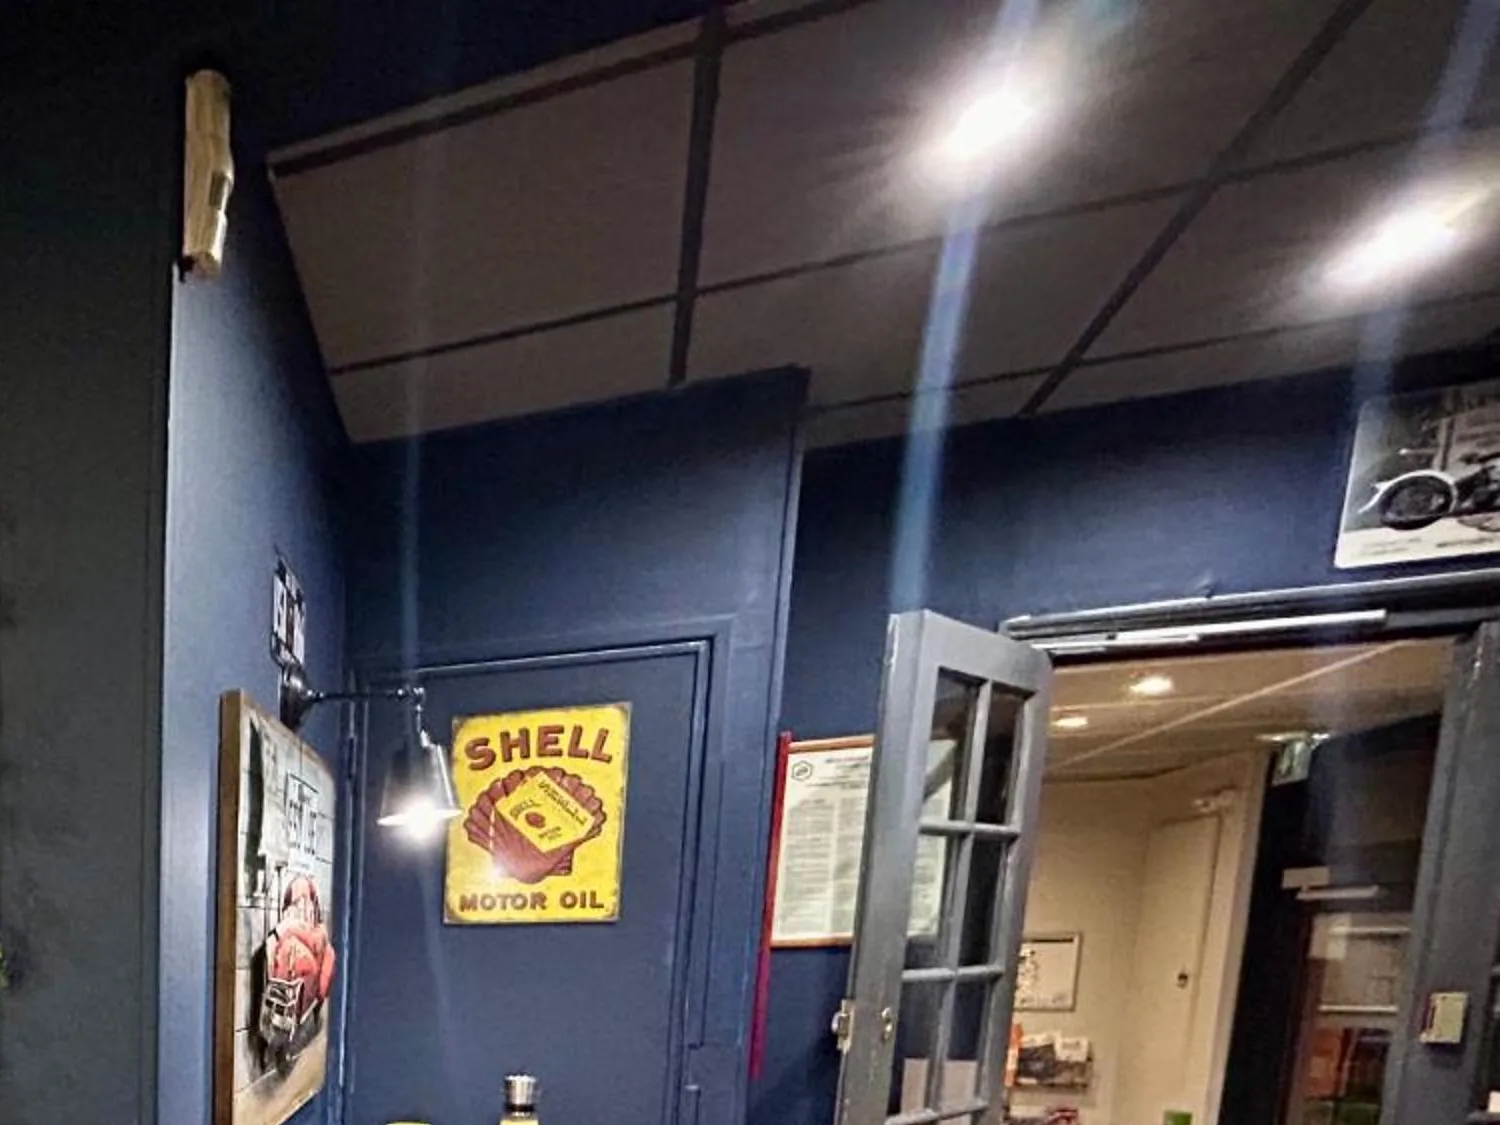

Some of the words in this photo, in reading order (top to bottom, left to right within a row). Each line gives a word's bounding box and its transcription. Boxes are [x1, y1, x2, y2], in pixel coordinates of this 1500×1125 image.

[465, 725, 613, 770] SHELL
[459, 892, 548, 913] MOTOR
[560, 891, 605, 909] OIL
